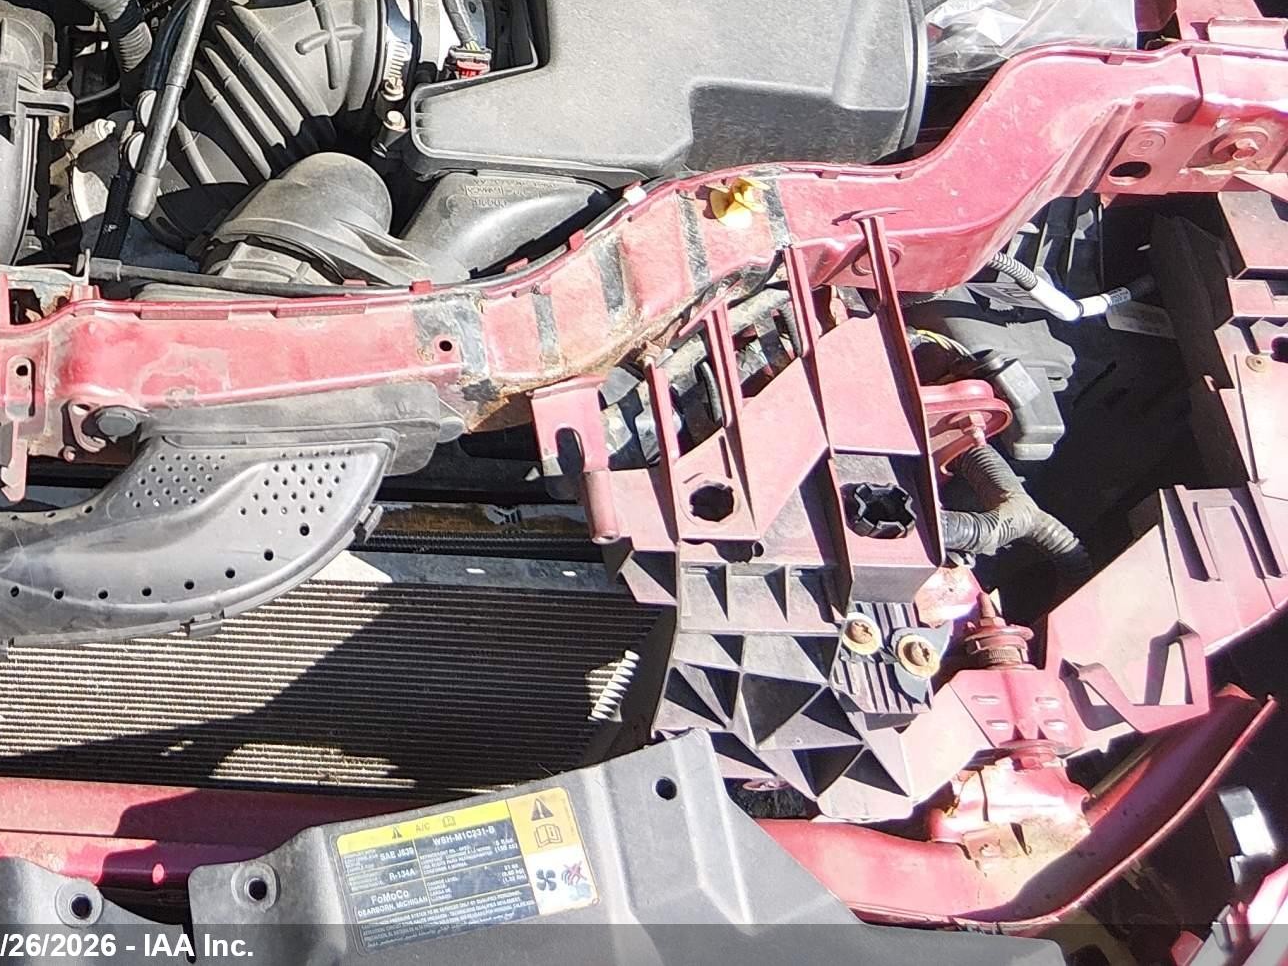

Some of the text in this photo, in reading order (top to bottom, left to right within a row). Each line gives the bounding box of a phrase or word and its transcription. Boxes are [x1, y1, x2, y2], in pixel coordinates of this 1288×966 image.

[416, 822, 430, 833] A/C
[389, 867, 416, 882] R-134A
[370, 890, 410, 906] FoMoCo
